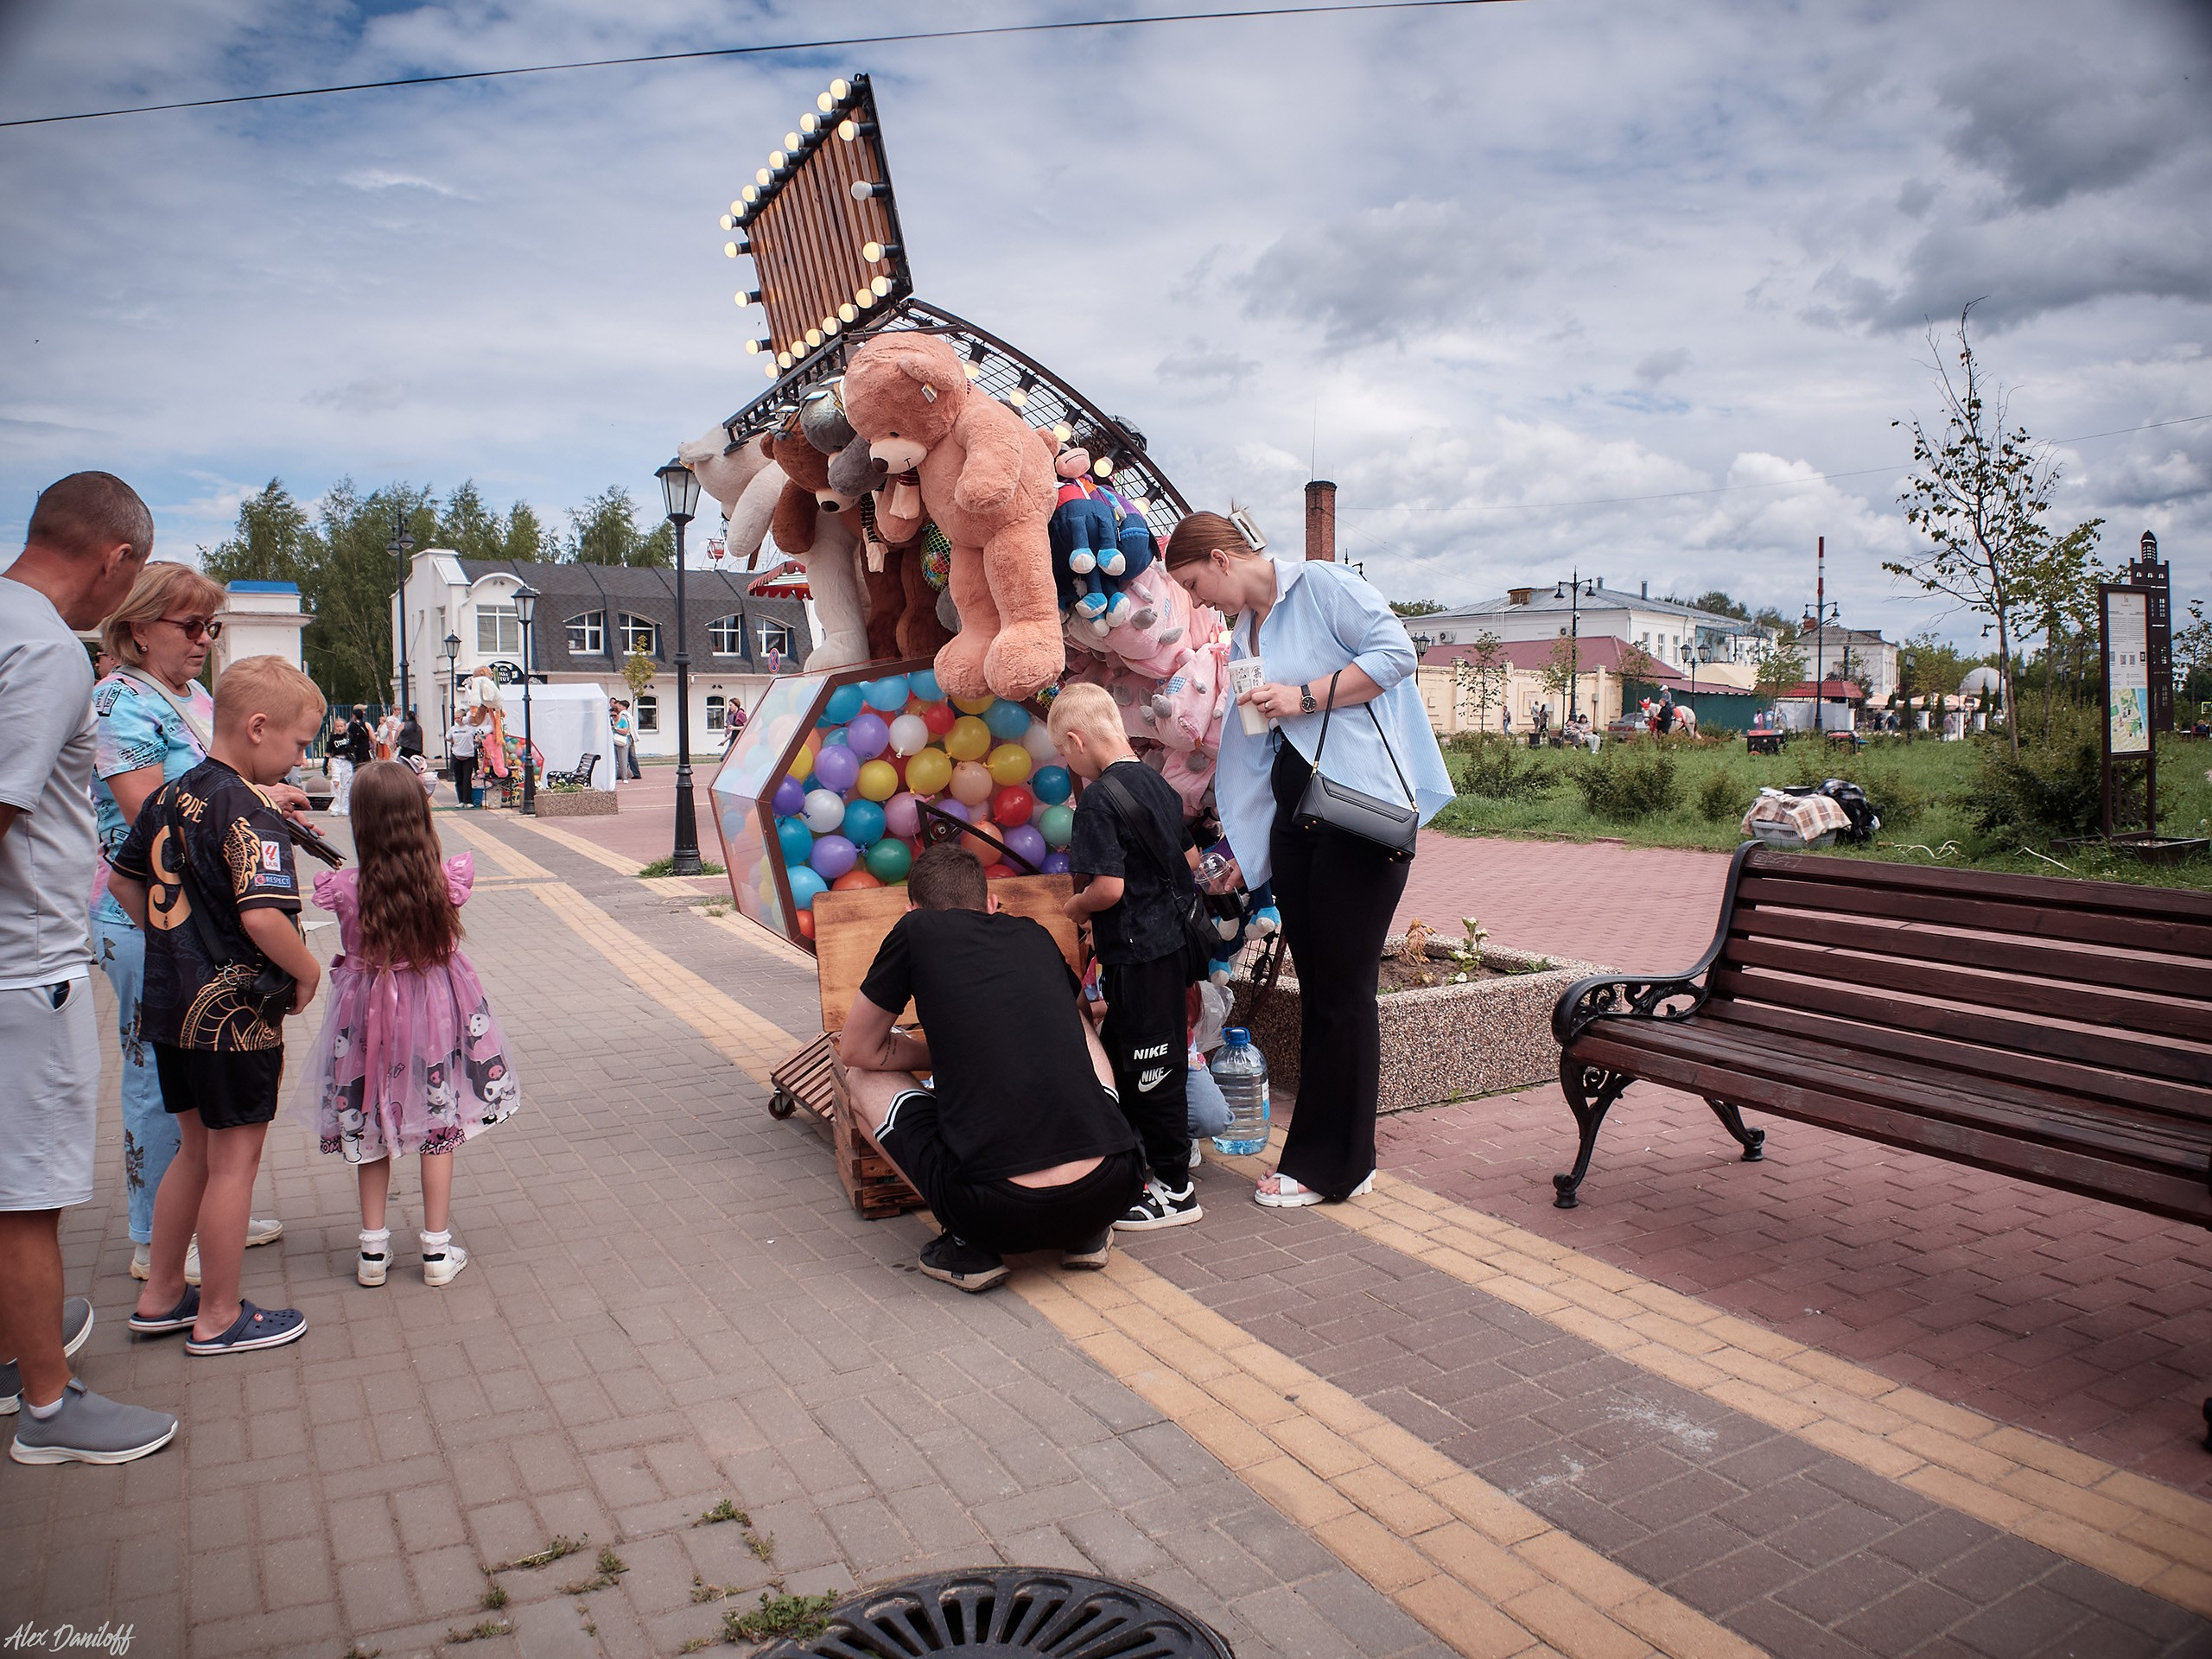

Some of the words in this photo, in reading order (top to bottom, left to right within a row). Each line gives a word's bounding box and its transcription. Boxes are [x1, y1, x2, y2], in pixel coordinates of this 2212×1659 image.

[149, 825, 193, 931] 9
[265, 876, 289, 885] RESPECT
[1134, 1043, 1169, 1060] NIKE
[1141, 1066, 1165, 1083] NIKE
